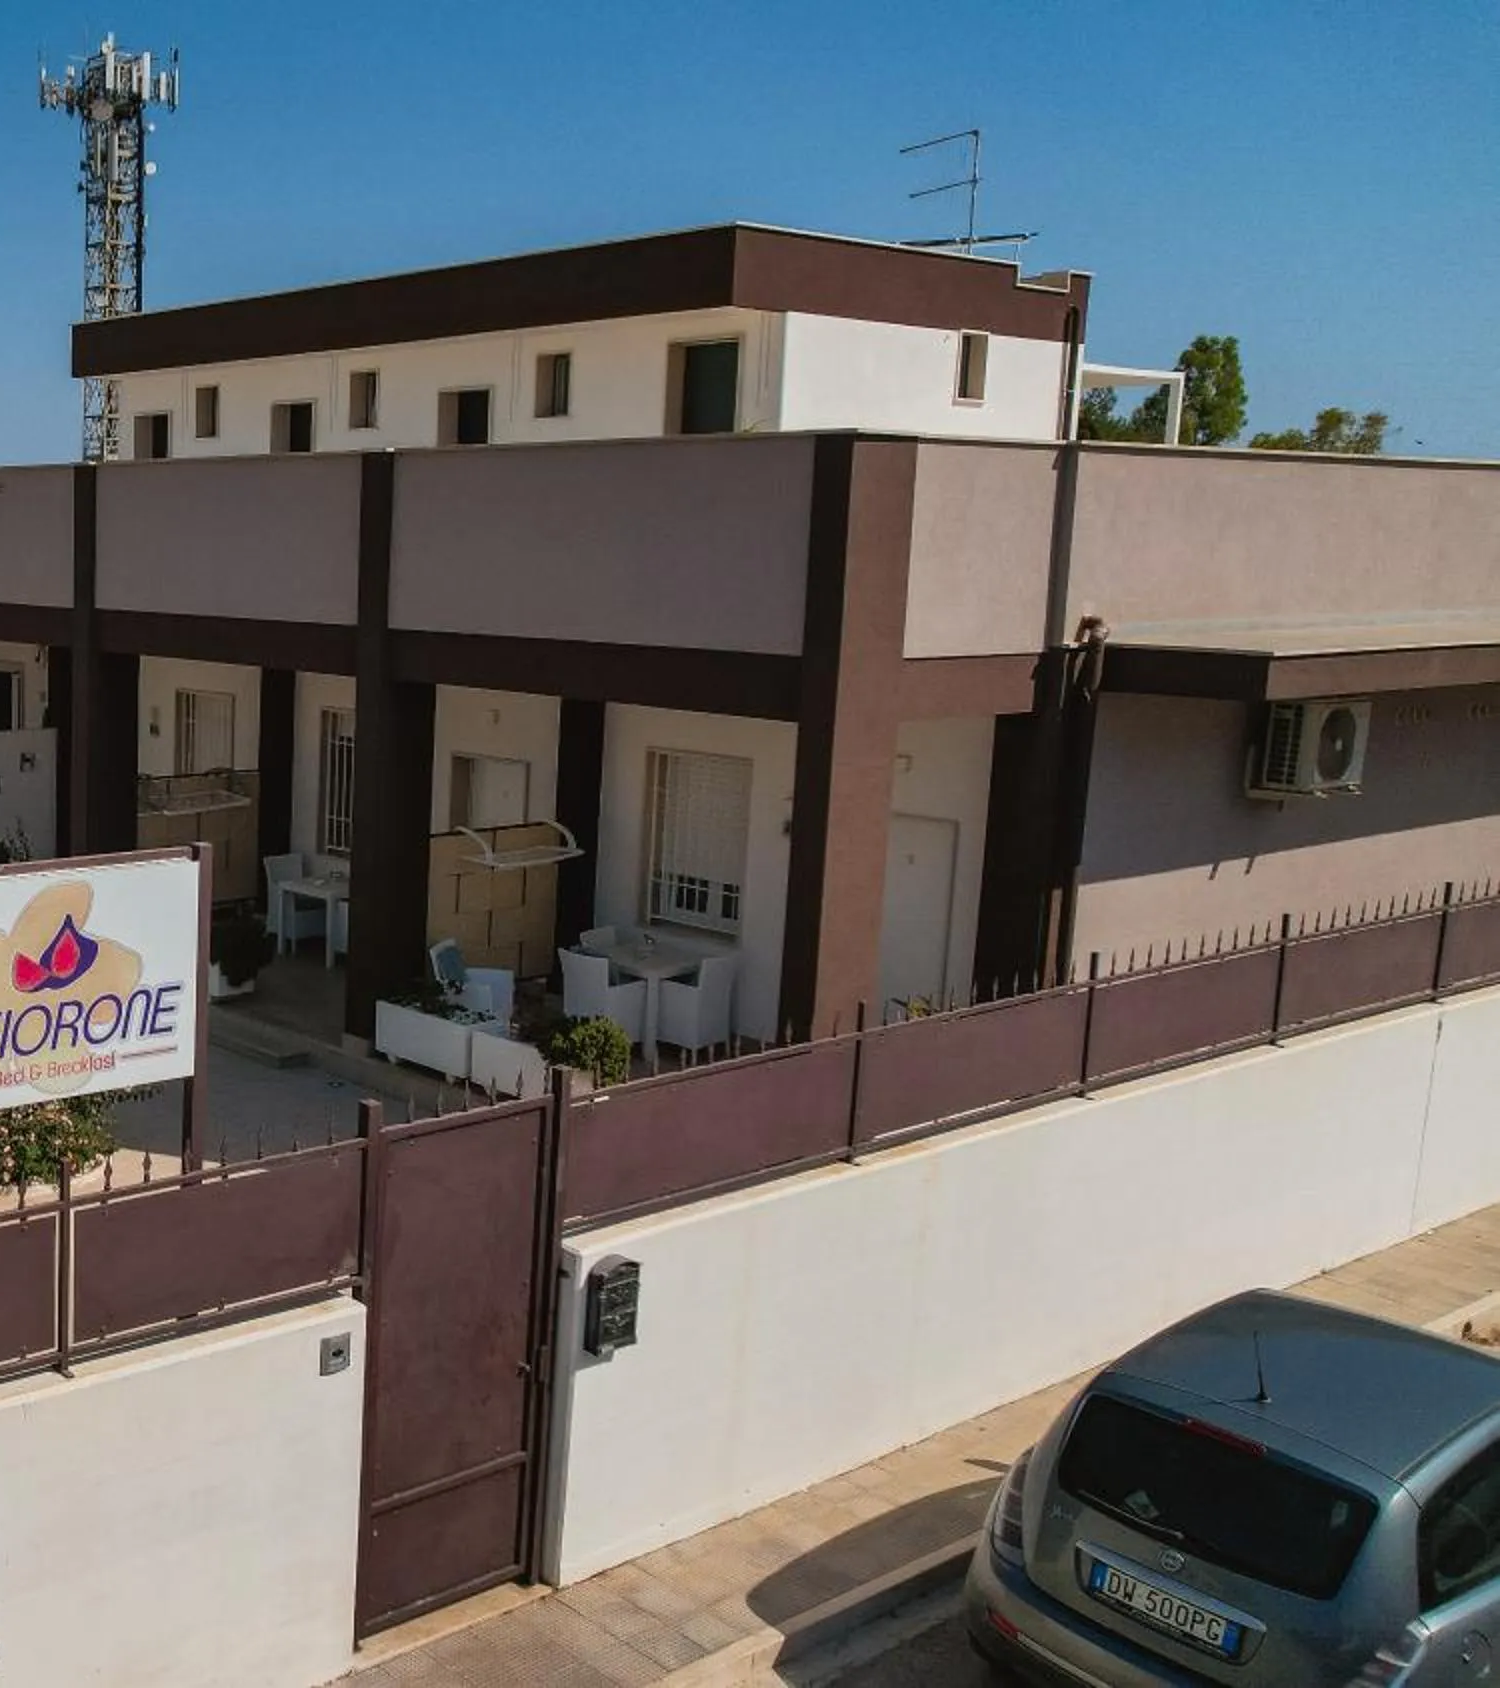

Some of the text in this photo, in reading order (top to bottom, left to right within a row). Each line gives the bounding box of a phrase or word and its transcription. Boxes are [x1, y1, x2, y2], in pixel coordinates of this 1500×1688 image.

[28, 1064, 44, 1081] &
[47, 1051, 117, 1079] Breakfast
[1107, 1571, 1222, 1642] DW 500PG
